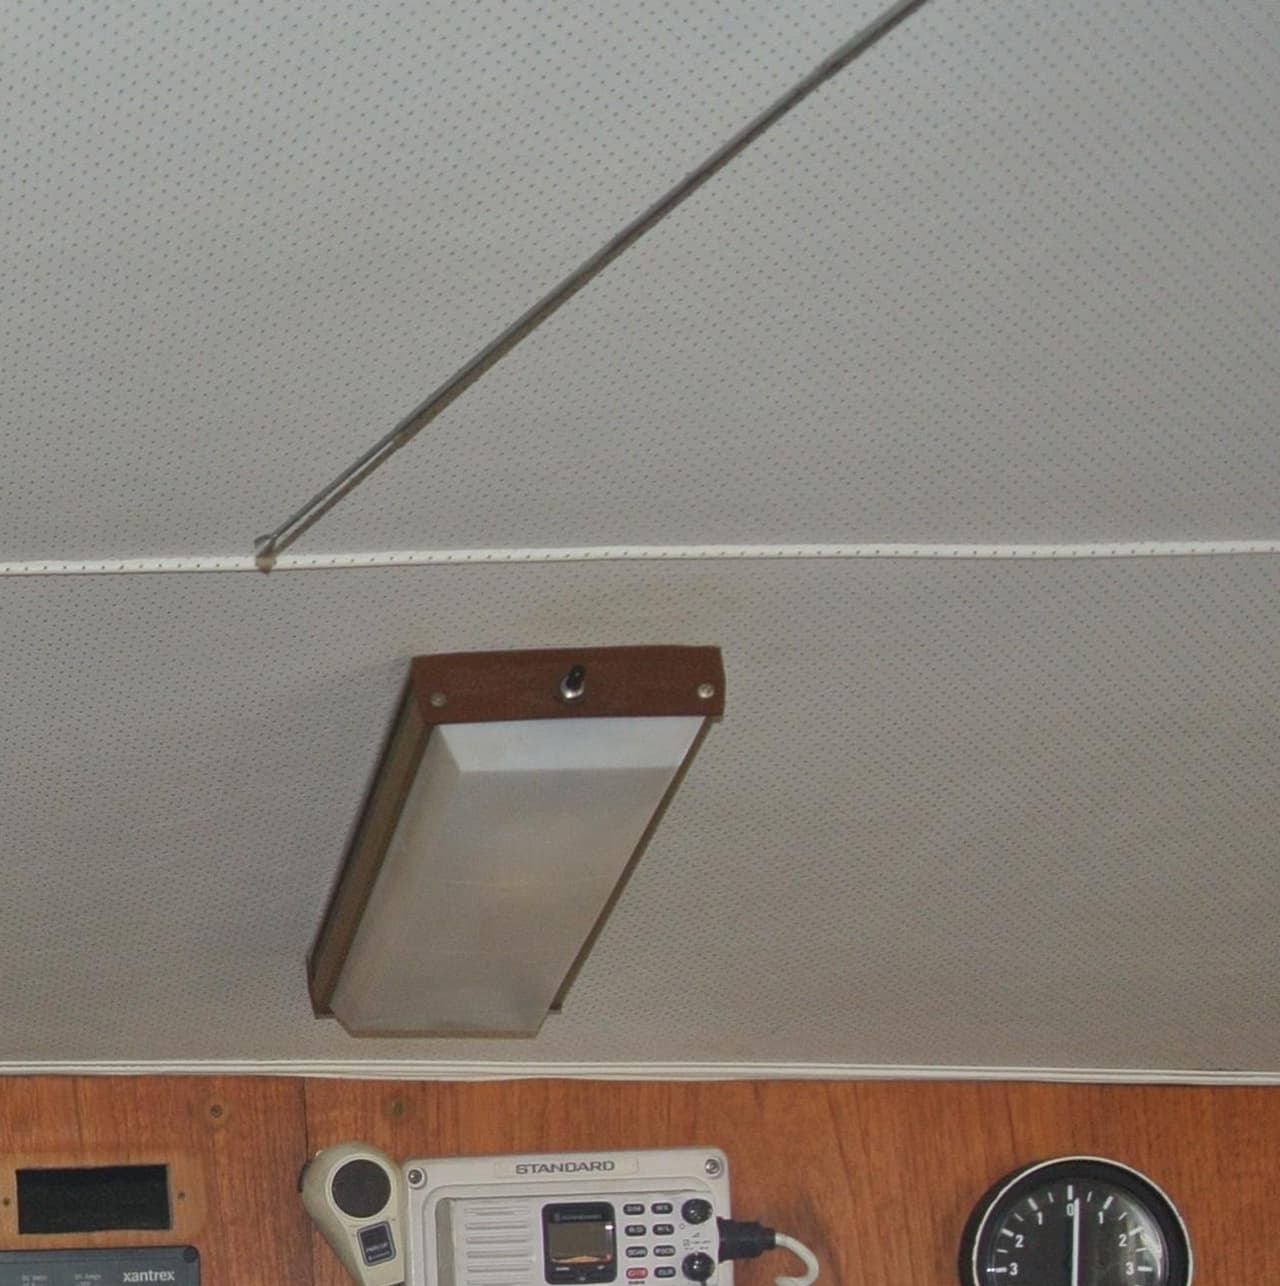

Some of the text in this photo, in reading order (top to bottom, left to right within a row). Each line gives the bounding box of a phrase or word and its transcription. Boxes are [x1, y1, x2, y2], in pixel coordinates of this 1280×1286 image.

[515, 1160, 615, 1174] STANDARD
[1037, 1211, 1043, 1225] 1
[1098, 1211, 1104, 1225] 1
[1015, 1234, 1024, 1248] 2
[1118, 1233, 1127, 1247] 2
[1009, 1262, 1018, 1276] 3
[1126, 1262, 1135, 1275] 3
[122, 1270, 176, 1282] xantrex
